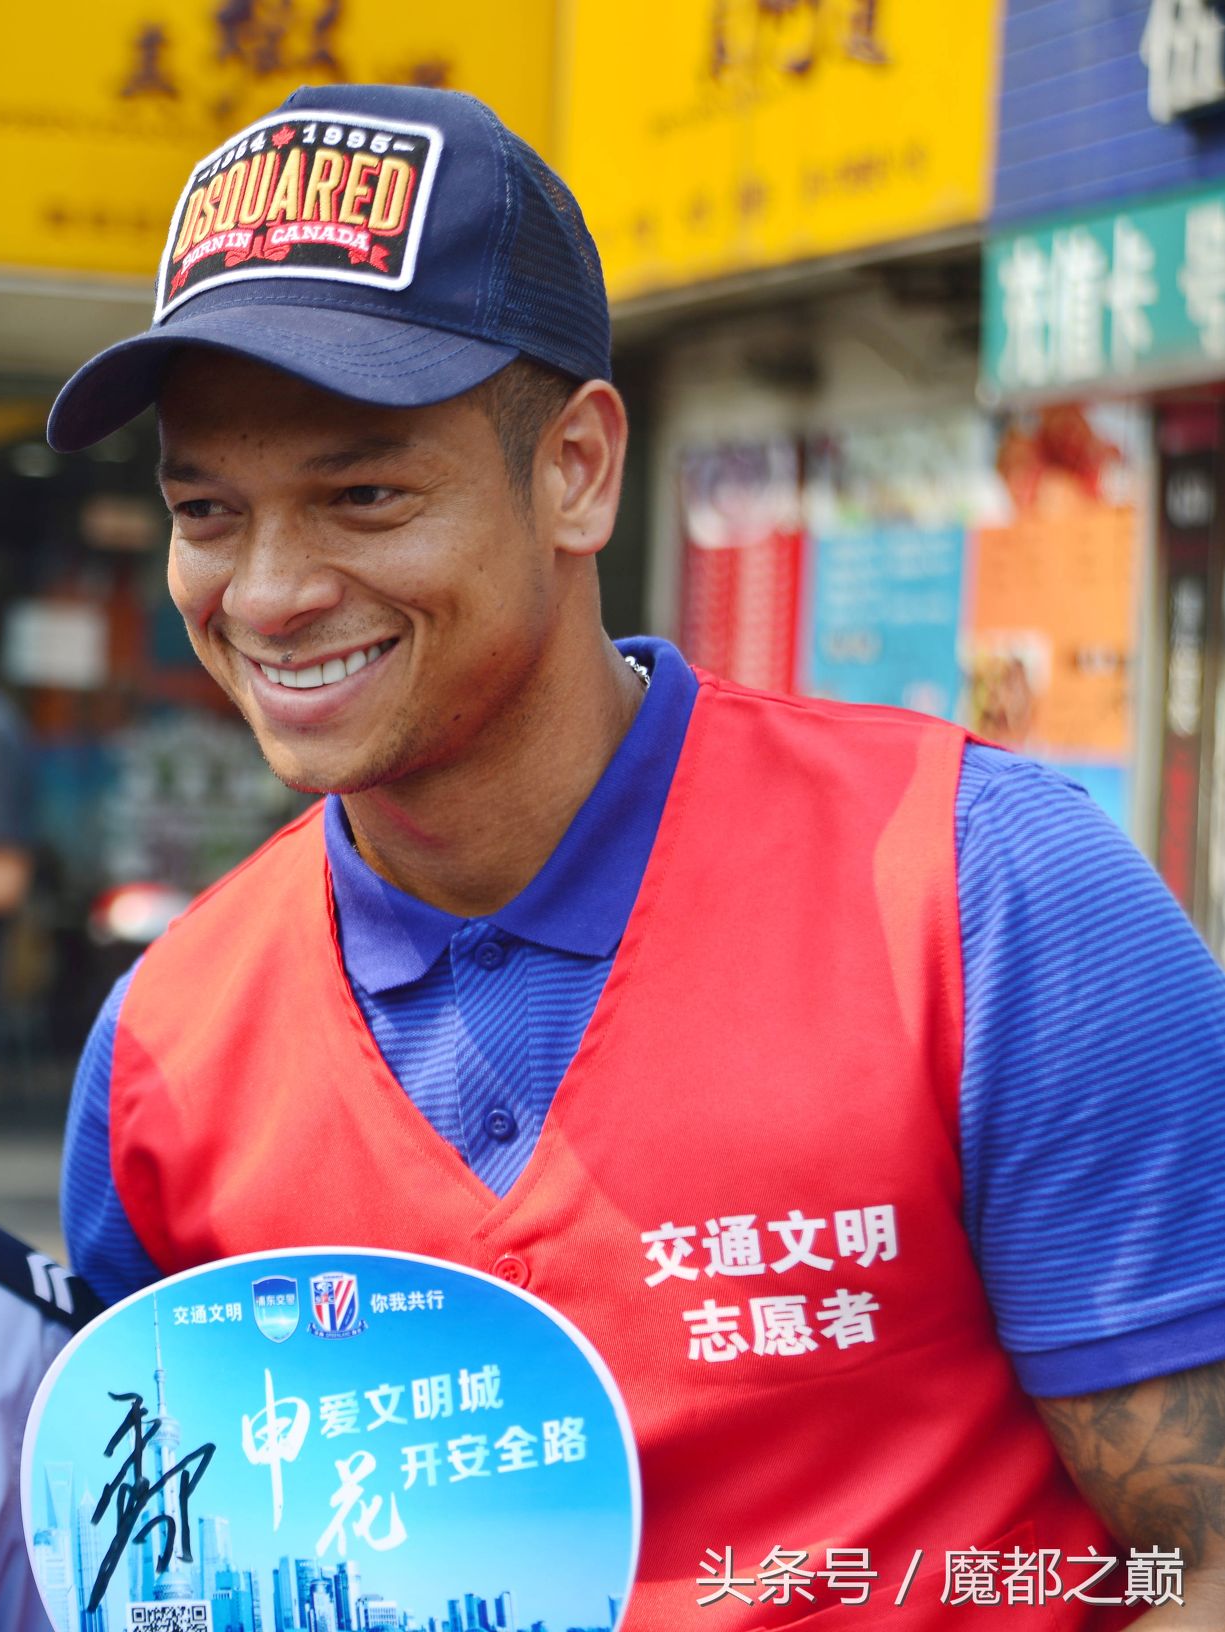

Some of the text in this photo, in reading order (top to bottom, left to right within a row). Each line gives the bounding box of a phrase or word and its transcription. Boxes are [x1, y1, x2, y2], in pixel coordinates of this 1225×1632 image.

[172, 145, 418, 264] DSQUARED
[270, 224, 371, 252] CANADA
[641, 1204, 898, 1288] 交通文明
[172, 1302, 243, 1325] 交通文明
[369, 1289, 445, 1314] 你我共行
[682, 1288, 880, 1363] 志愿者
[319, 1364, 504, 1439] 爱文明城
[401, 1416, 588, 1491] 开安全路
